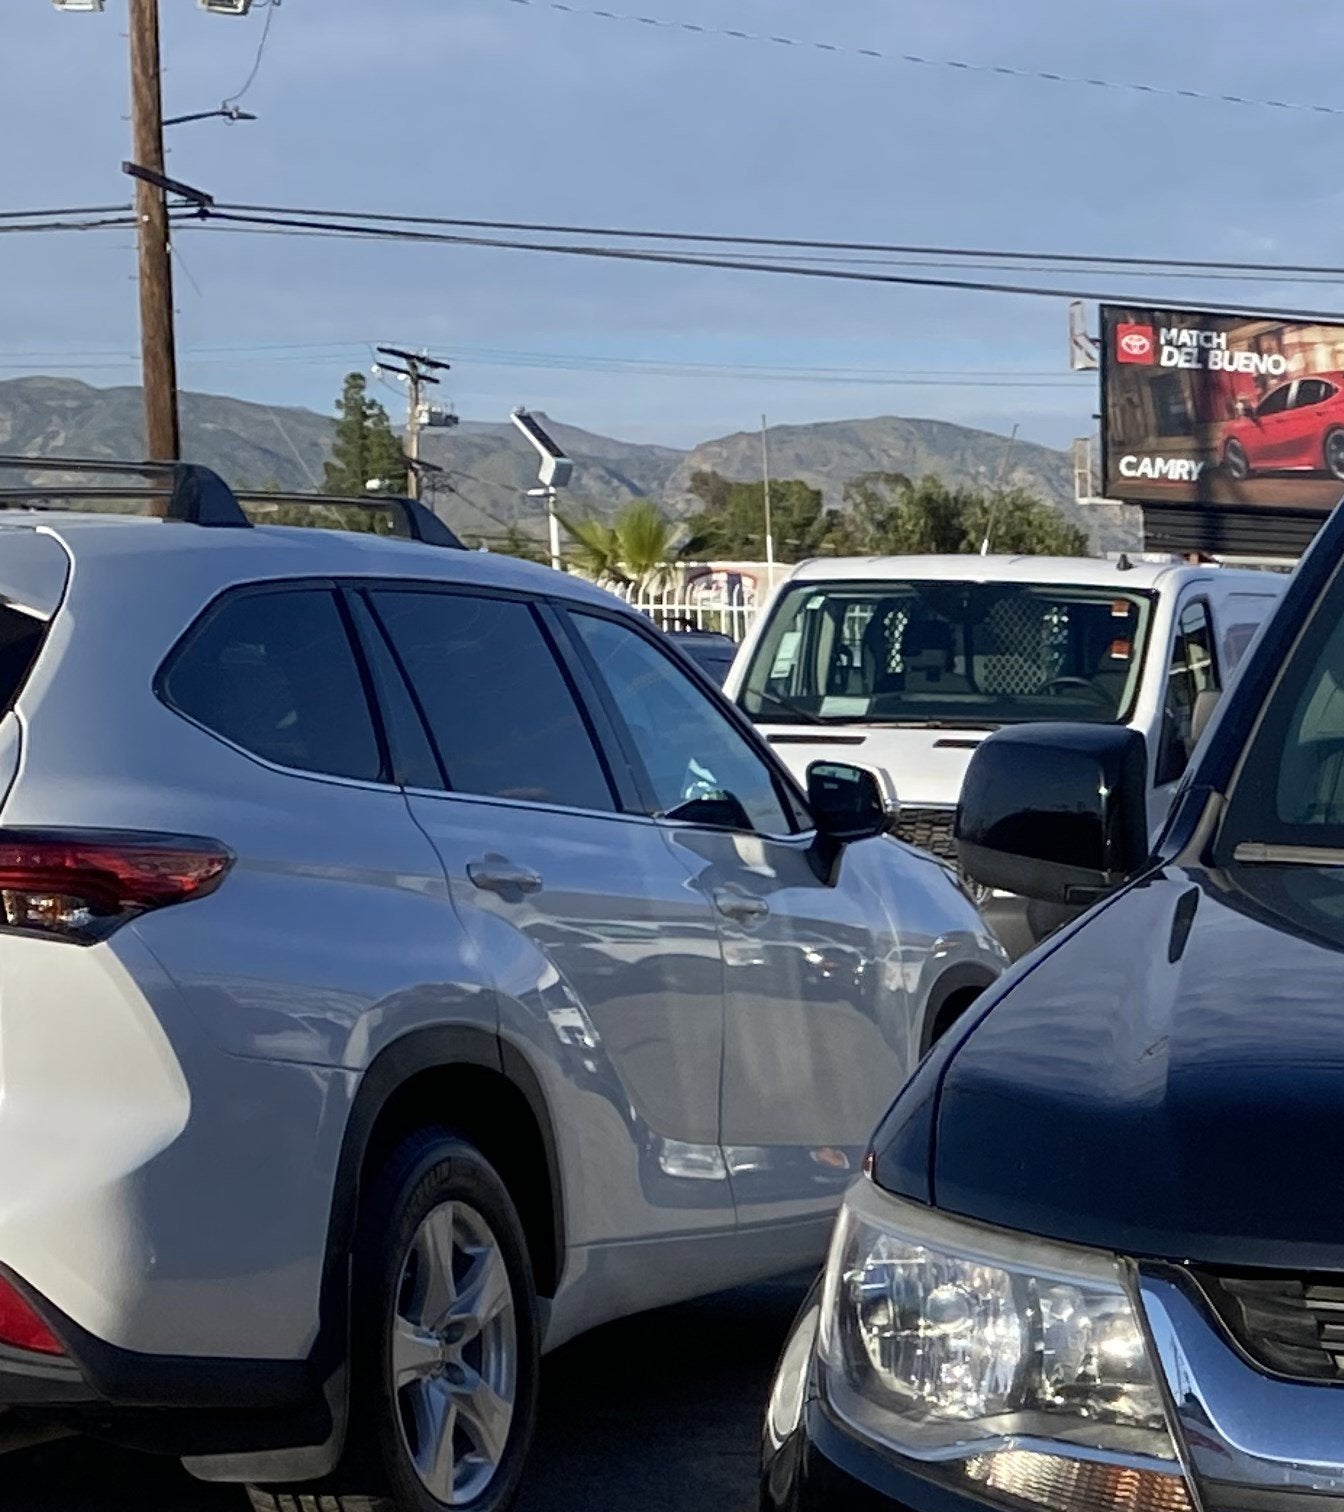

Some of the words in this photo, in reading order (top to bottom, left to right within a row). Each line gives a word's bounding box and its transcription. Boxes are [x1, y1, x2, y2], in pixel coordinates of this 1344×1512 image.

[1159, 326, 1227, 350] MATCH
[1160, 349, 1204, 370] DEL
[1208, 350, 1287, 376] BUENO
[1119, 454, 1204, 482] CAMRY
